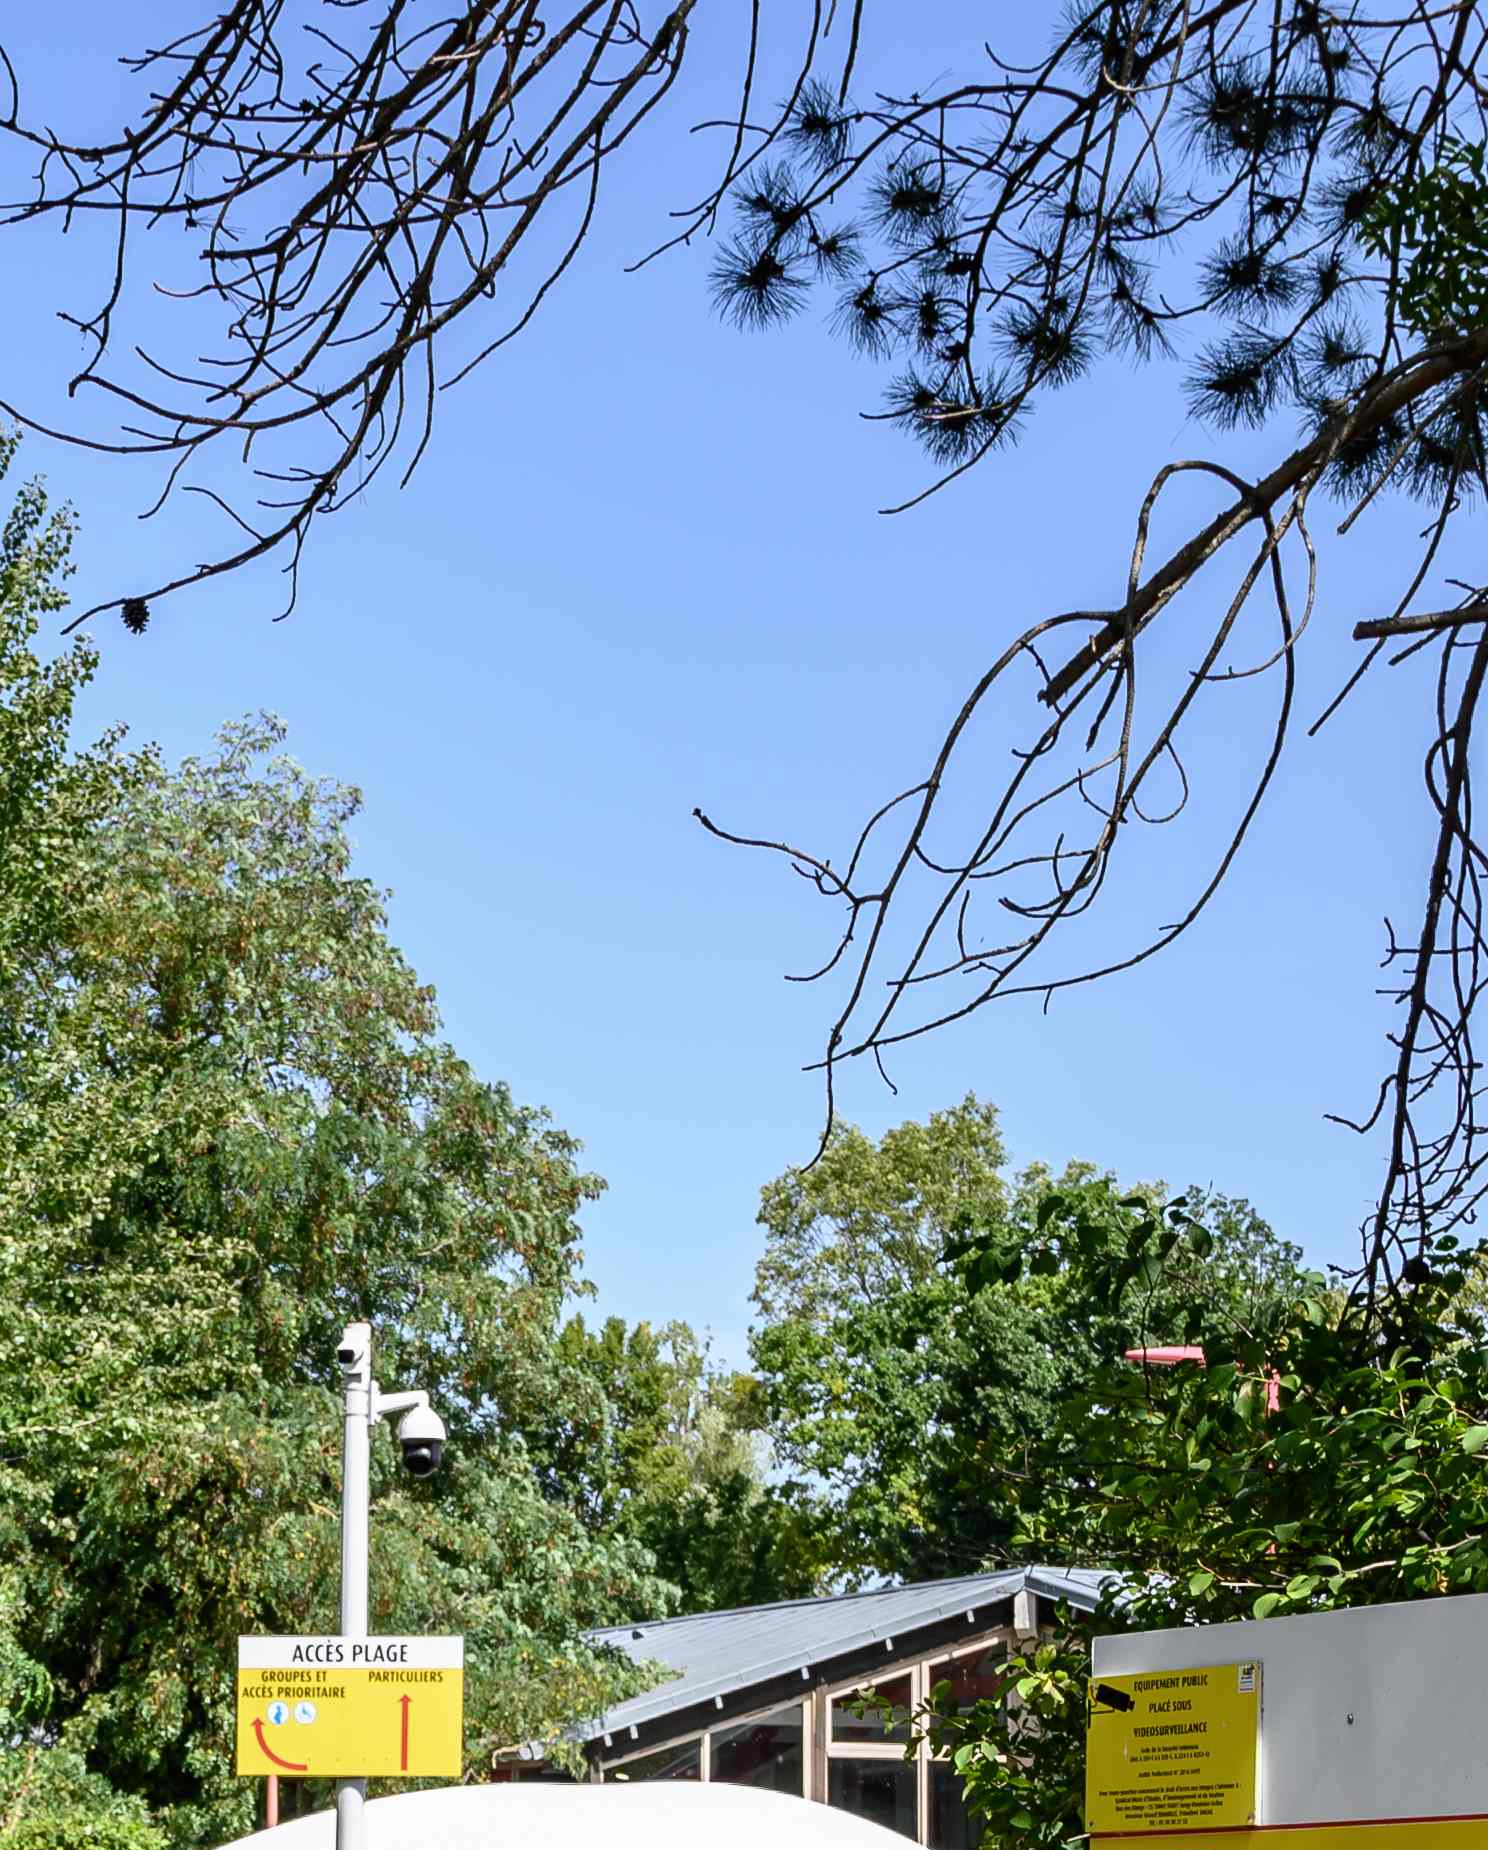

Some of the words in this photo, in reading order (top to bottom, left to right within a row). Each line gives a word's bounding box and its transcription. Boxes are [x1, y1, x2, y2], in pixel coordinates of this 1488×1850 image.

[292, 1640, 344, 1662] ACCÈS
[353, 1644, 408, 1662] PLAGE
[261, 1671, 311, 1682] GROUPES
[316, 1671, 326, 1681] ET
[368, 1671, 443, 1682] PARTICULIERS
[1134, 1677, 1180, 1692] EQUIPEMENT
[1182, 1675, 1208, 1687] PUBLIC
[242, 1684, 273, 1697] ACCÈS
[277, 1687, 345, 1698] PRIORITAIRE
[1149, 1699, 1170, 1713] PLACÉ
[1173, 1700, 1192, 1711] SOUS
[1134, 1722, 1207, 1738] VIDEOSURVEILLANCE
